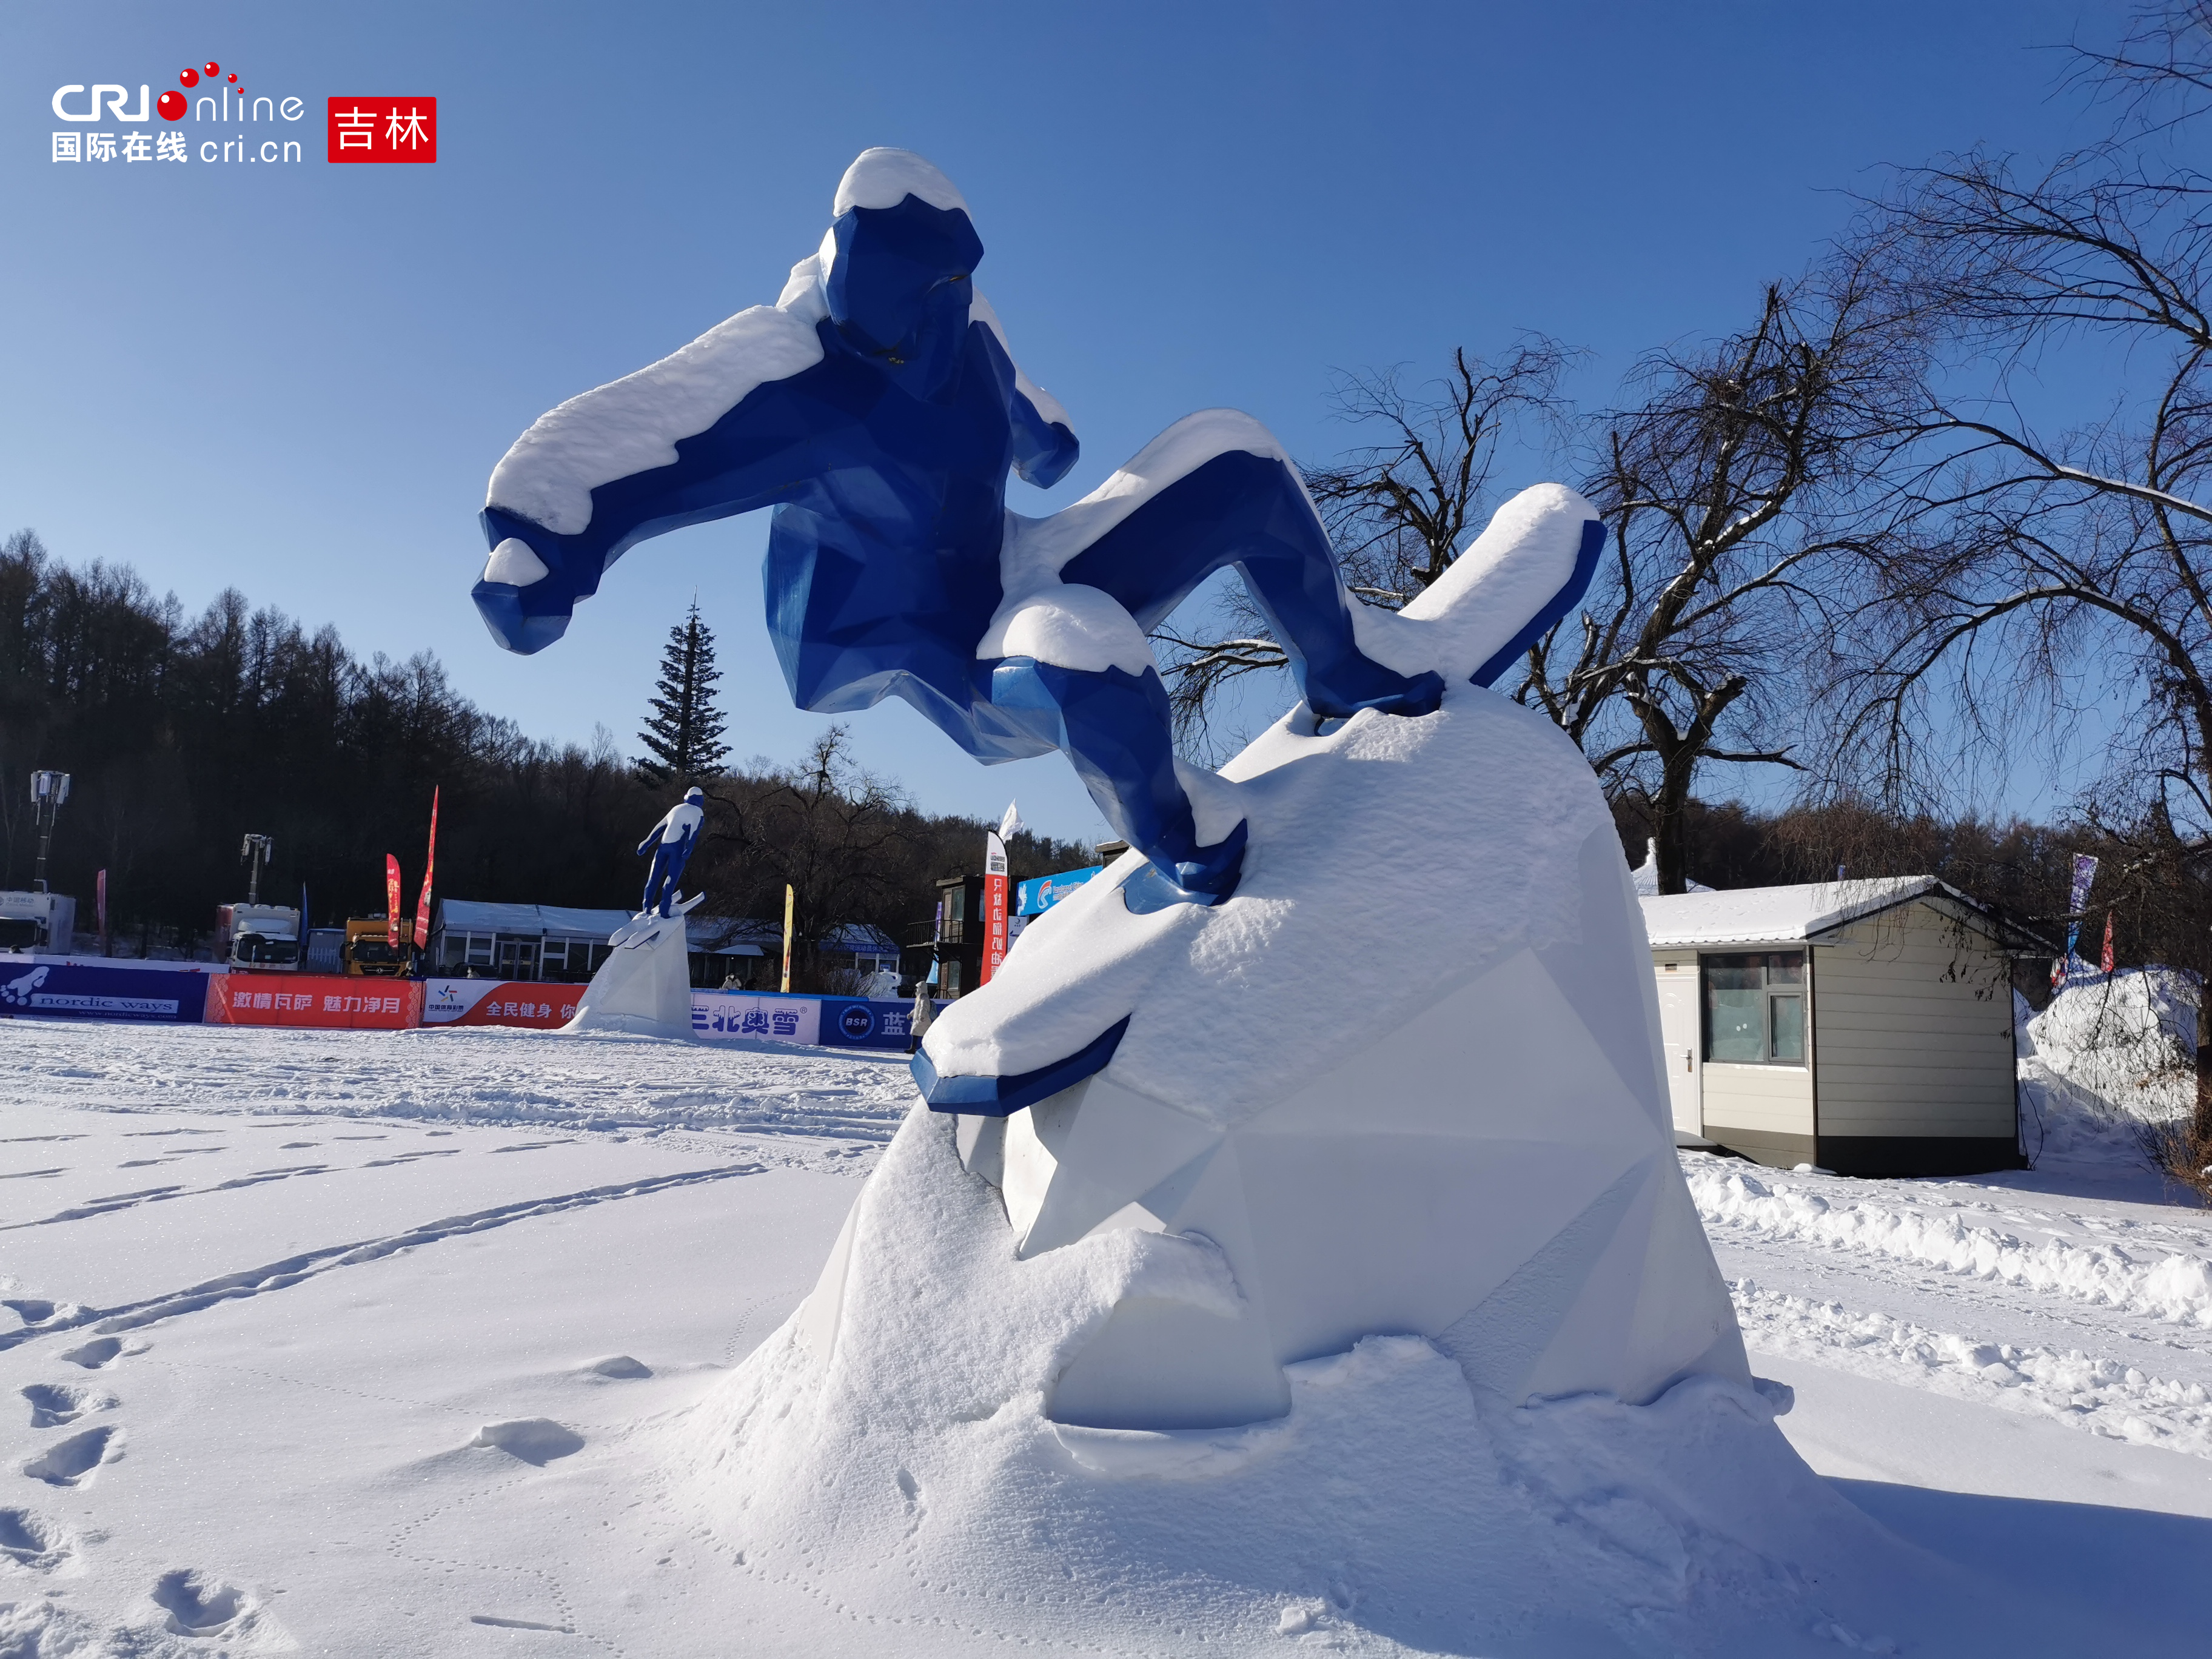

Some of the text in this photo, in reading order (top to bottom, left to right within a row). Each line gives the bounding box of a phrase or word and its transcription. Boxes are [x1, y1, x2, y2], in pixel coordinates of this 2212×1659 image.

[40, 997, 173, 1013] nordic ways
[232, 991, 400, 1013] 激情瓦萨 魅力净月
[486, 1001, 552, 1018] 全民健身
[845, 1017, 868, 1027] BSR
